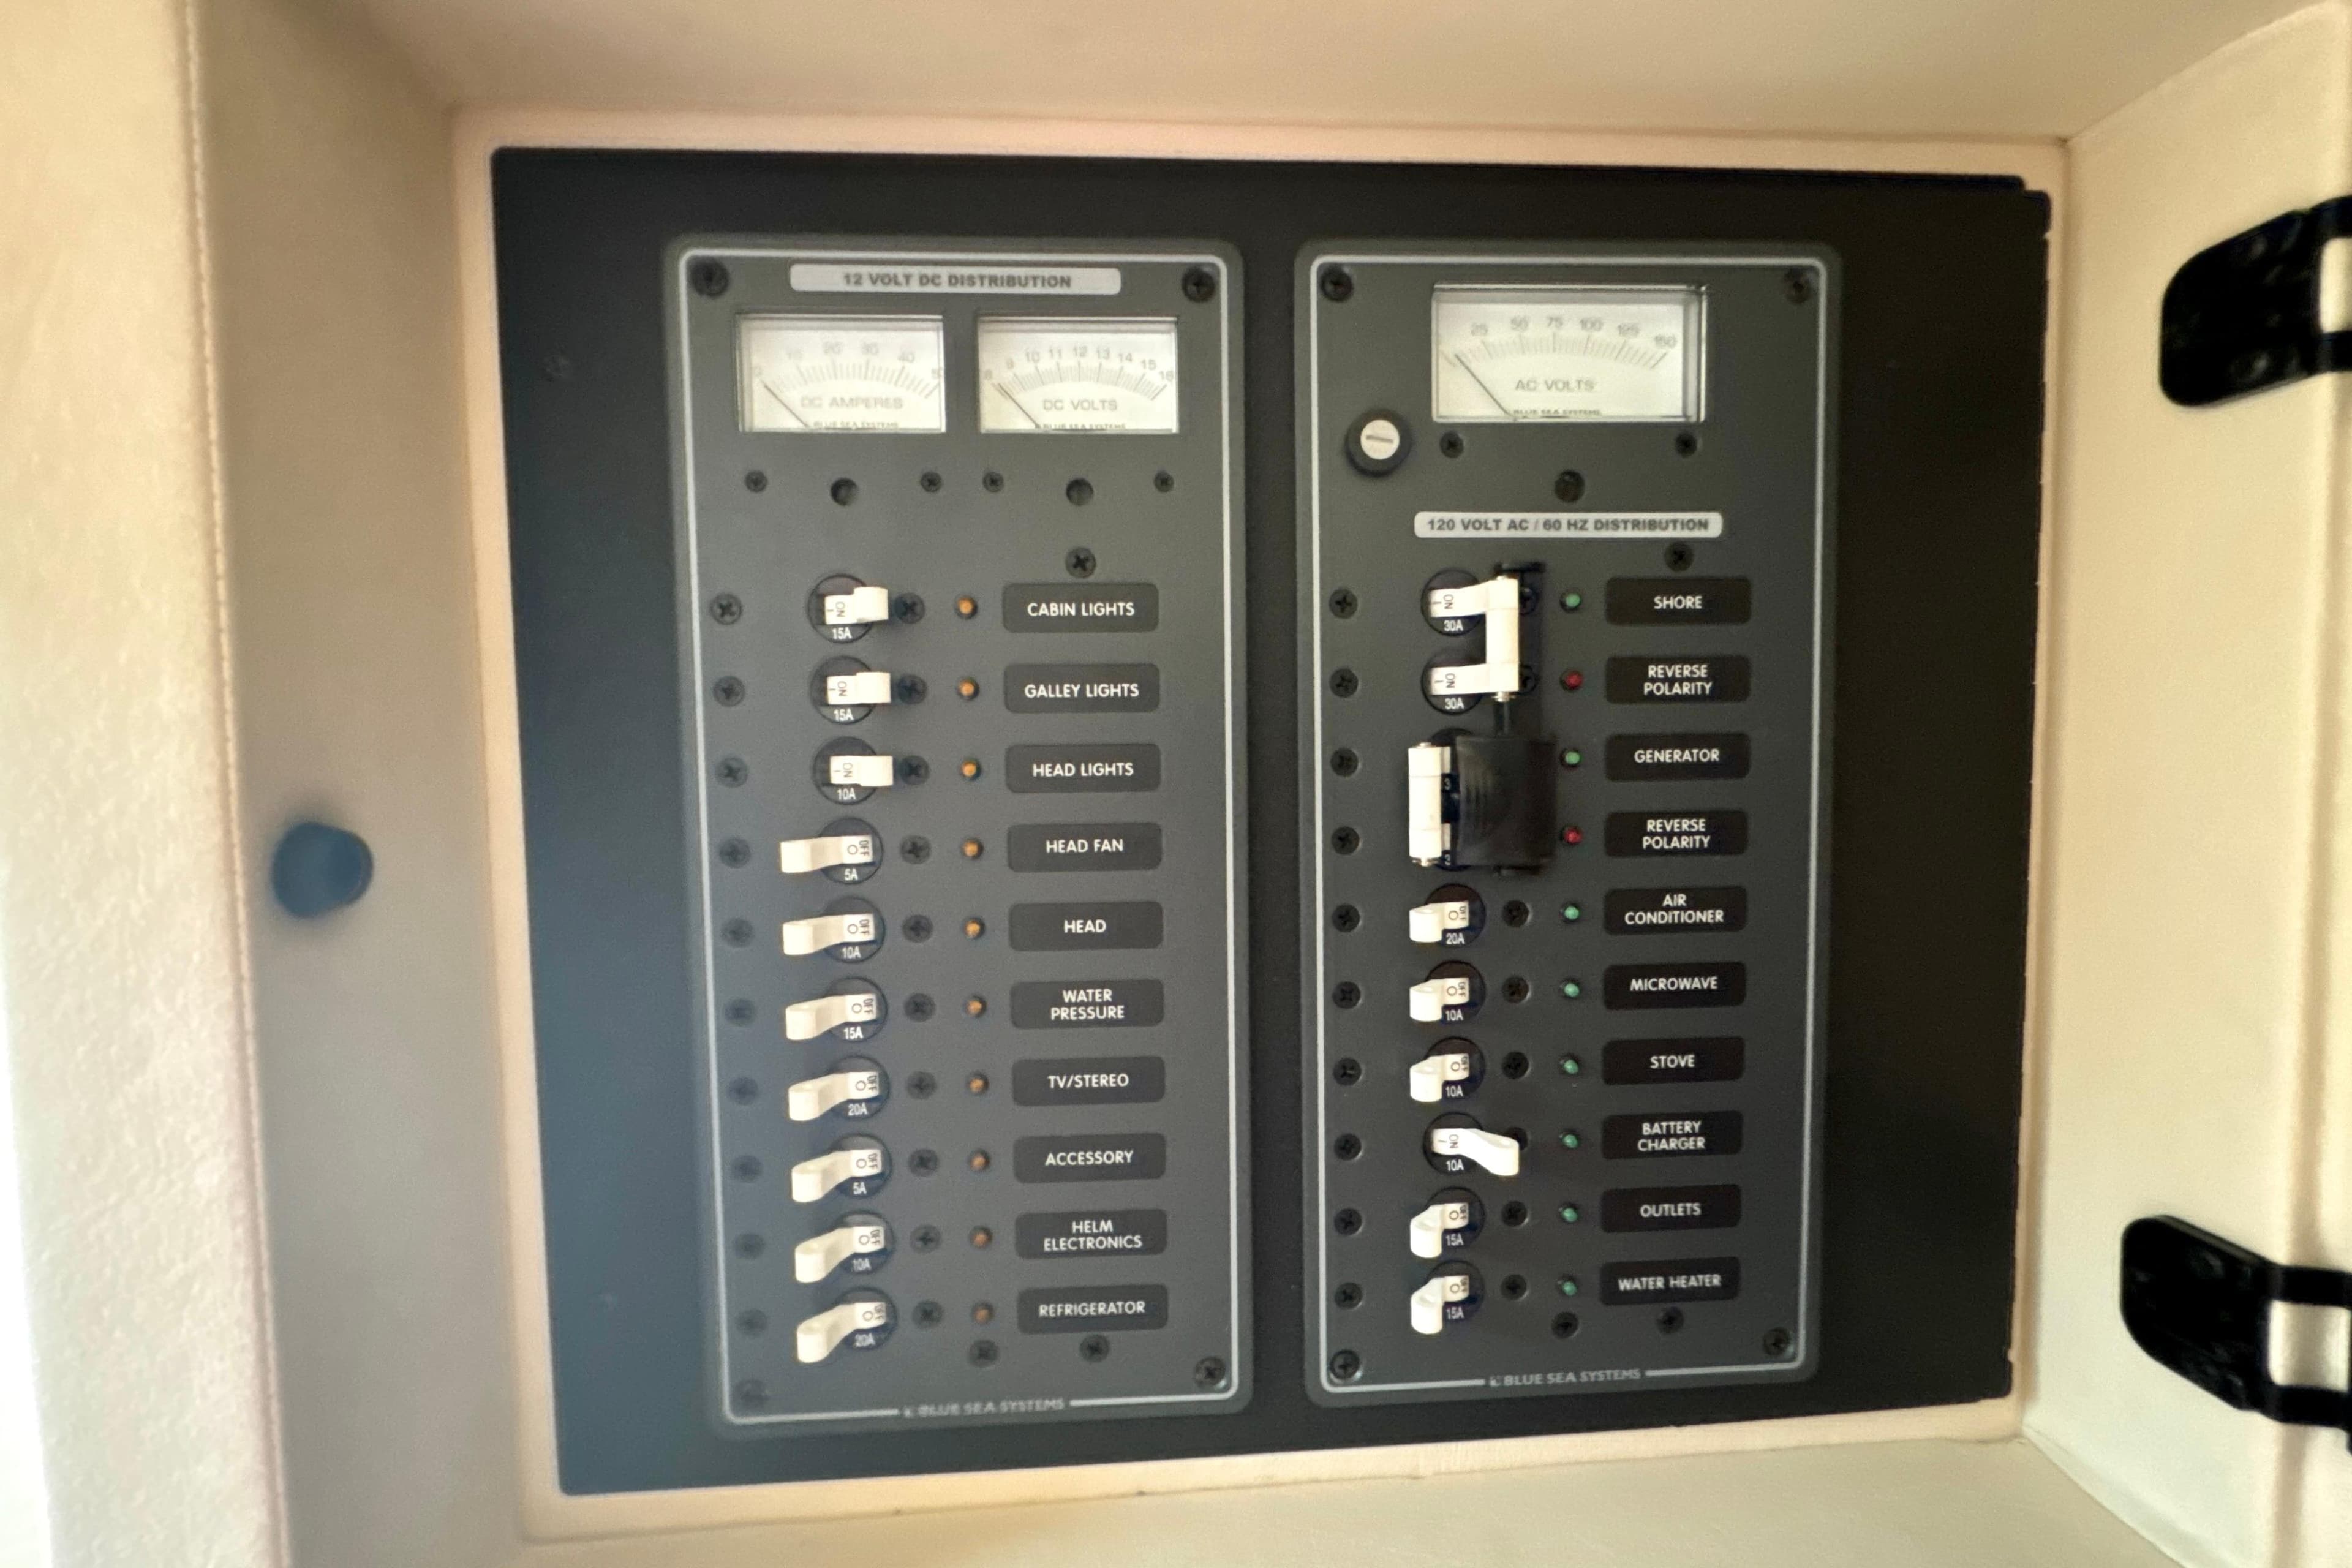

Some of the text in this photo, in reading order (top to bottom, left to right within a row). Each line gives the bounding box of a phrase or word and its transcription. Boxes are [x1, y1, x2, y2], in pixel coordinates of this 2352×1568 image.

[843, 272, 1072, 288] 12 VOLT DC DISTRIBUTION
[1471, 323, 1488, 336] 25
[1510, 316, 1529, 331] 50
[1547, 316, 1564, 329] 75
[1580, 317, 1604, 331] 100
[1618, 323, 1640, 337] 125
[824, 342, 843, 355] 20
[1049, 348, 1063, 359] 11
[1073, 345, 1087, 357] 12
[1096, 347, 1110, 360] 13
[898, 350, 915, 363] 40
[1025, 352, 1041, 363] 10
[1118, 353, 1133, 363] 14
[1141, 359, 1156, 370] 15
[1159, 370, 1174, 382] 16
[1515, 379, 1596, 392] AC VOLTS
[801, 396, 903, 409] DC AMPERES
[1042, 399, 1117, 411] DC VOLTS
[1428, 519, 1456, 531] 120
[1460, 519, 1502, 531] VOLT
[1507, 519, 1529, 532] AC
[1542, 519, 1562, 532] 60
[1566, 519, 1589, 532] HZ
[1594, 518, 1709, 532] DISTRIBUTION
[1443, 593, 1453, 609] ON
[1654, 595, 1702, 609] SHORE
[836, 601, 846, 617] ON
[1027, 601, 1135, 617] CABIN LIGHTS
[1444, 619, 1464, 632] 30A
[832, 627, 852, 640] 15A
[1648, 664, 1708, 679] REVERSE
[838, 680, 847, 696] ON
[1445, 673, 1455, 689] ON
[1024, 683, 1139, 698] GALLEY LIGHTS
[1643, 681, 1713, 696] POLARITY
[1445, 697, 1464, 710] 30A
[833, 708, 854, 722] 15A
[1634, 748, 1720, 763] GENERATOR
[843, 762, 853, 778] ON
[1033, 762, 1134, 777] HEAD LIGHTS
[837, 787, 856, 801] 10A
[1646, 818, 1706, 832] REVERSE
[859, 840, 870, 856] OFF
[1046, 839, 1123, 853] HEAD FAN
[1642, 835, 1711, 850] POLARITY
[844, 868, 858, 881] 5A
[1662, 894, 1687, 907] AIR
[1624, 909, 1724, 925] CONDITIONER
[859, 919, 870, 936] OFF
[1064, 919, 1107, 933] HEAD
[1446, 932, 1465, 945] 20A
[842, 946, 861, 959] 10A
[1630, 976, 1717, 991] MICROWAVE
[1062, 988, 1112, 1003] WATER
[862, 998, 874, 1015] OFF
[1050, 1005, 1125, 1020] PRESSURE
[1445, 1009, 1464, 1022] 10A
[843, 1026, 864, 1039] 15A
[1650, 1054, 1695, 1069] STOVE
[867, 1074, 877, 1092] OFF
[1047, 1073, 1129, 1088] TV/STEREO
[1446, 1085, 1464, 1098] 10A
[848, 1102, 868, 1116] 20A
[1642, 1120, 1701, 1136] BATTERY
[1449, 1134, 1459, 1149] ON
[1637, 1136, 1705, 1152] CHARGER
[867, 1152, 878, 1170] OFF
[1045, 1150, 1134, 1166] ACCESSORY
[1446, 1159, 1464, 1172] 10A
[853, 1182, 867, 1195] 5A
[1640, 1202, 1701, 1218] OUTLETS
[1072, 1219, 1114, 1234] HELM
[870, 1229, 880, 1246] OFF
[1043, 1235, 1142, 1252] ELECTRONICS
[1446, 1233, 1464, 1246] 15A
[852, 1257, 871, 1271] 10A
[1618, 1273, 1721, 1291] WATER HEATER
[1039, 1300, 1145, 1317] REFRIGERATOR
[1446, 1306, 1464, 1319] 15A
[855, 1332, 875, 1348] 20A
[1503, 1368, 1642, 1386] BLUE SEA SYSTEMS
[919, 1397, 1065, 1417] BLUE SEA SYSTEMS
